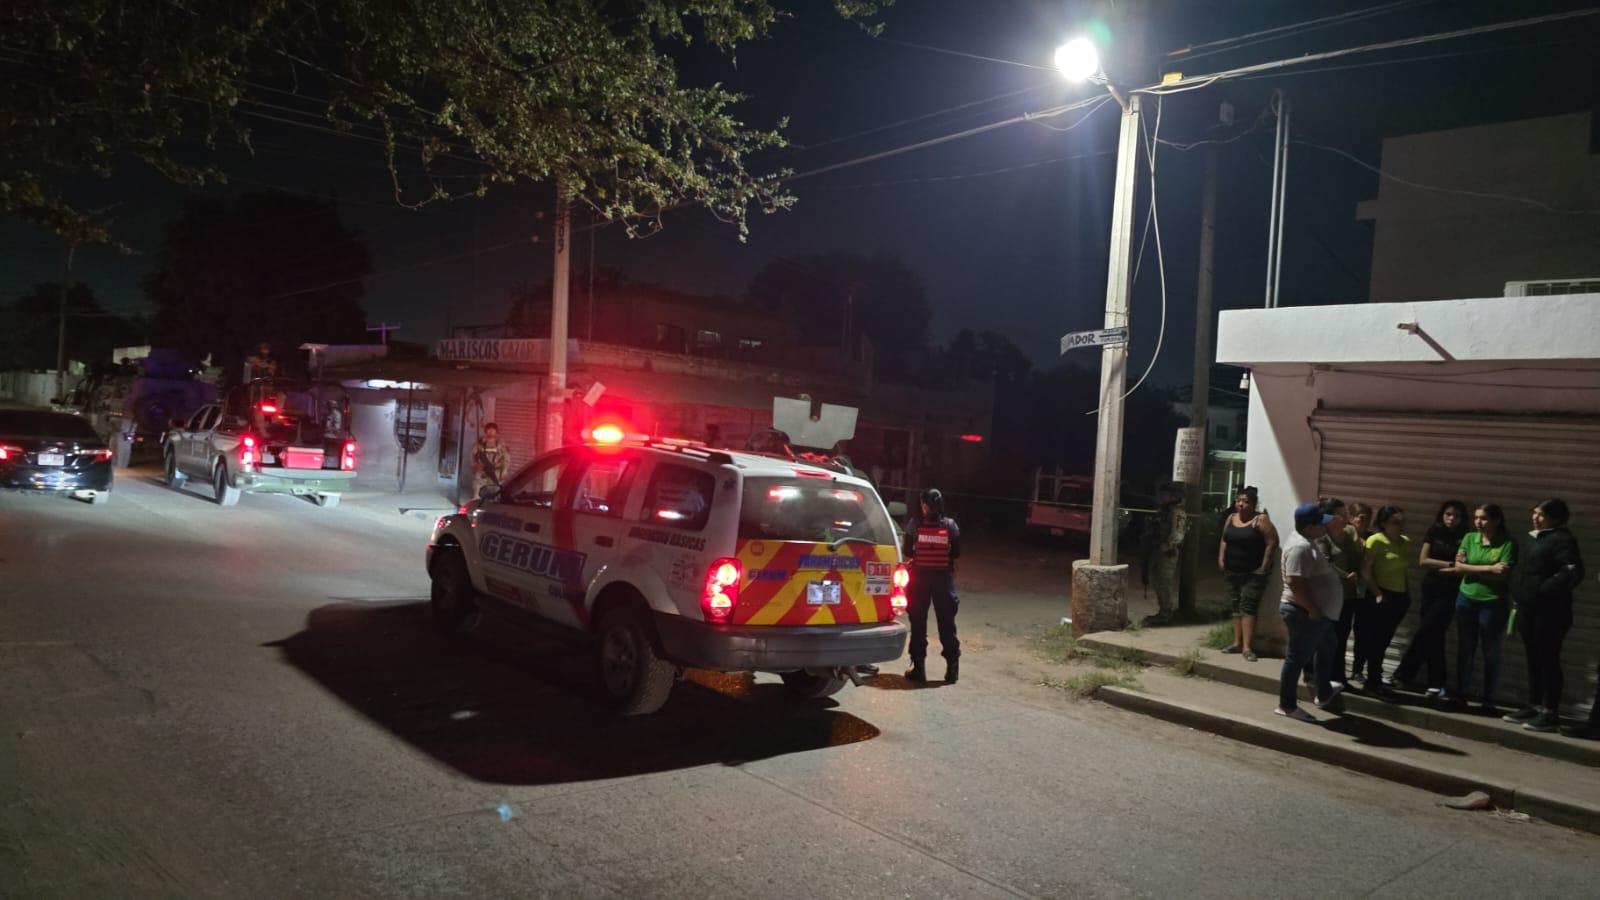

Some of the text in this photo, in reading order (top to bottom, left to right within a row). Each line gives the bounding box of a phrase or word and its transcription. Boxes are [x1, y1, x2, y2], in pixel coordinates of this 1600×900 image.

[438, 341, 499, 361] MARISCOS
[481, 532, 585, 580] GERUM
[866, 563, 890, 576] 911
